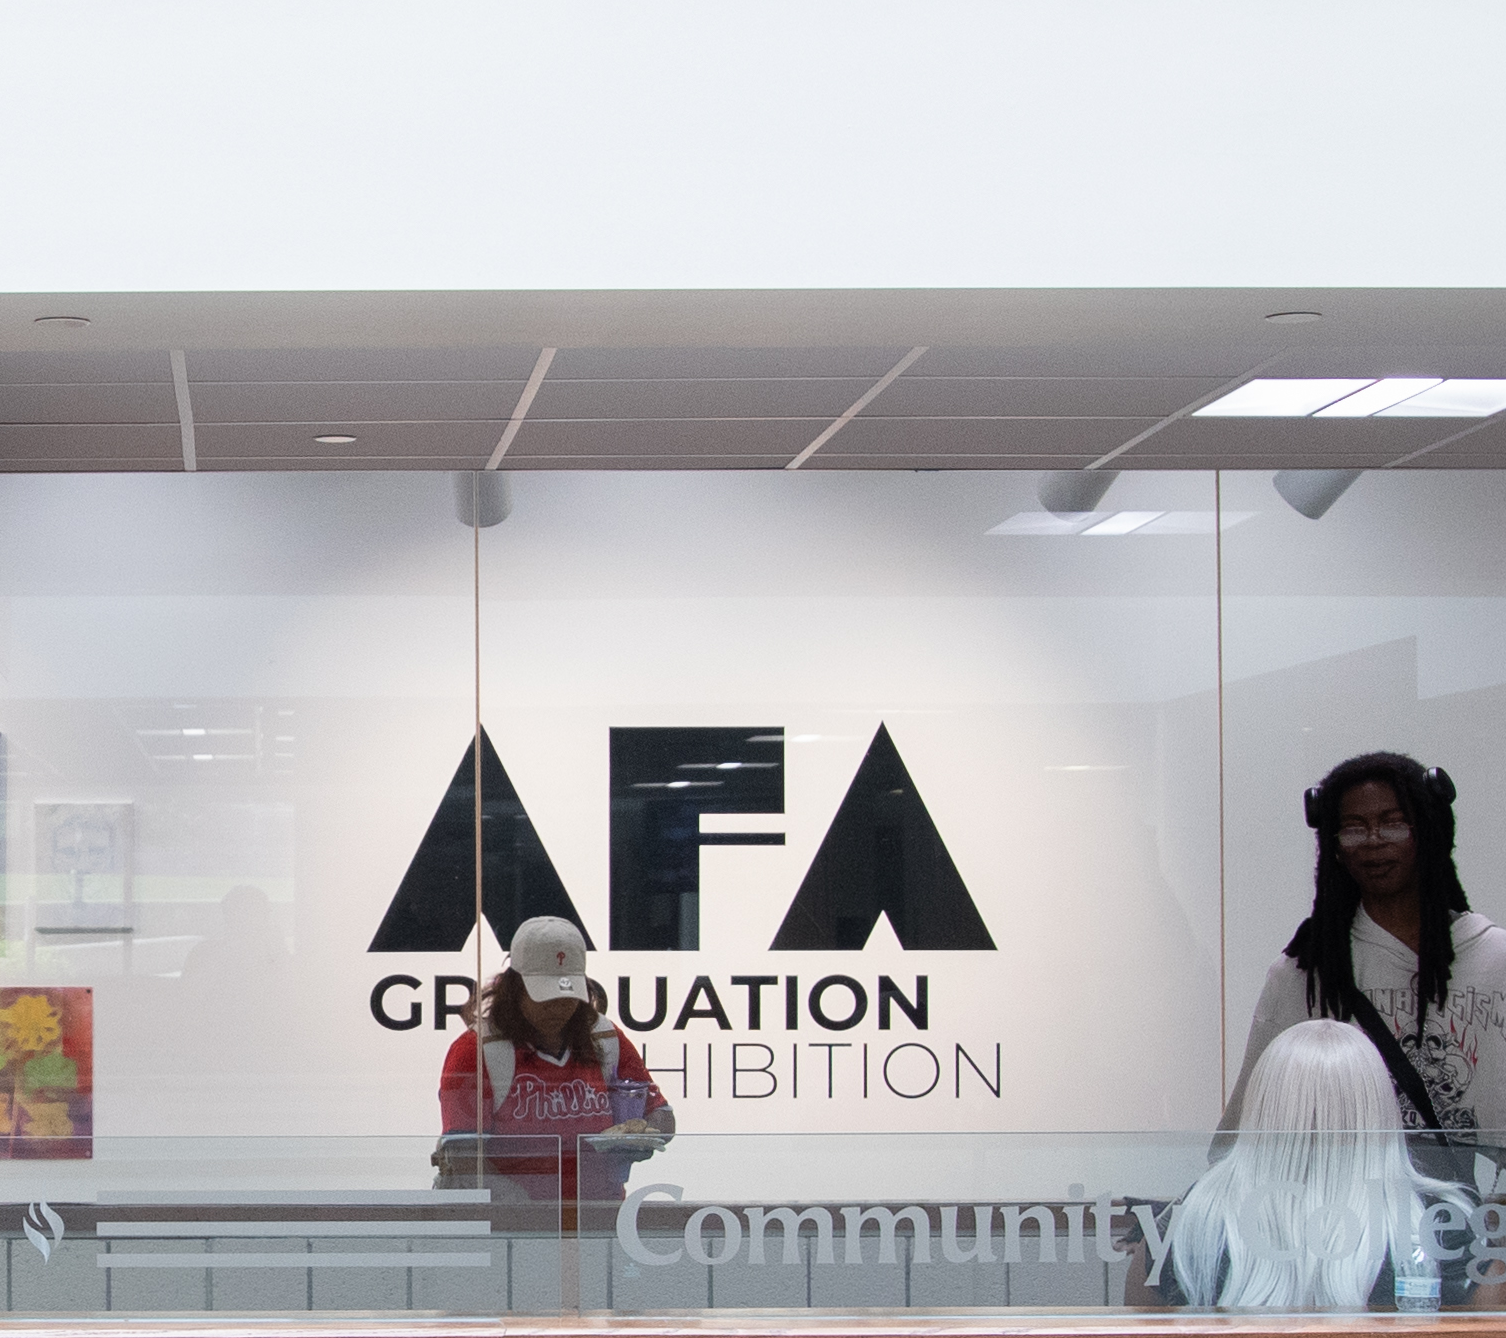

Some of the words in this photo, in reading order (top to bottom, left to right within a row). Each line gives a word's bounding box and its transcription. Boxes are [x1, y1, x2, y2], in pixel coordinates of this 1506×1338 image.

[367, 720, 997, 953] AFA
[370, 975, 929, 1031] GRUATION
[510, 1073, 612, 1119] Phillie
[643, 1042, 1002, 1099] HIBITION
[616, 1181, 1182, 1286] Community
